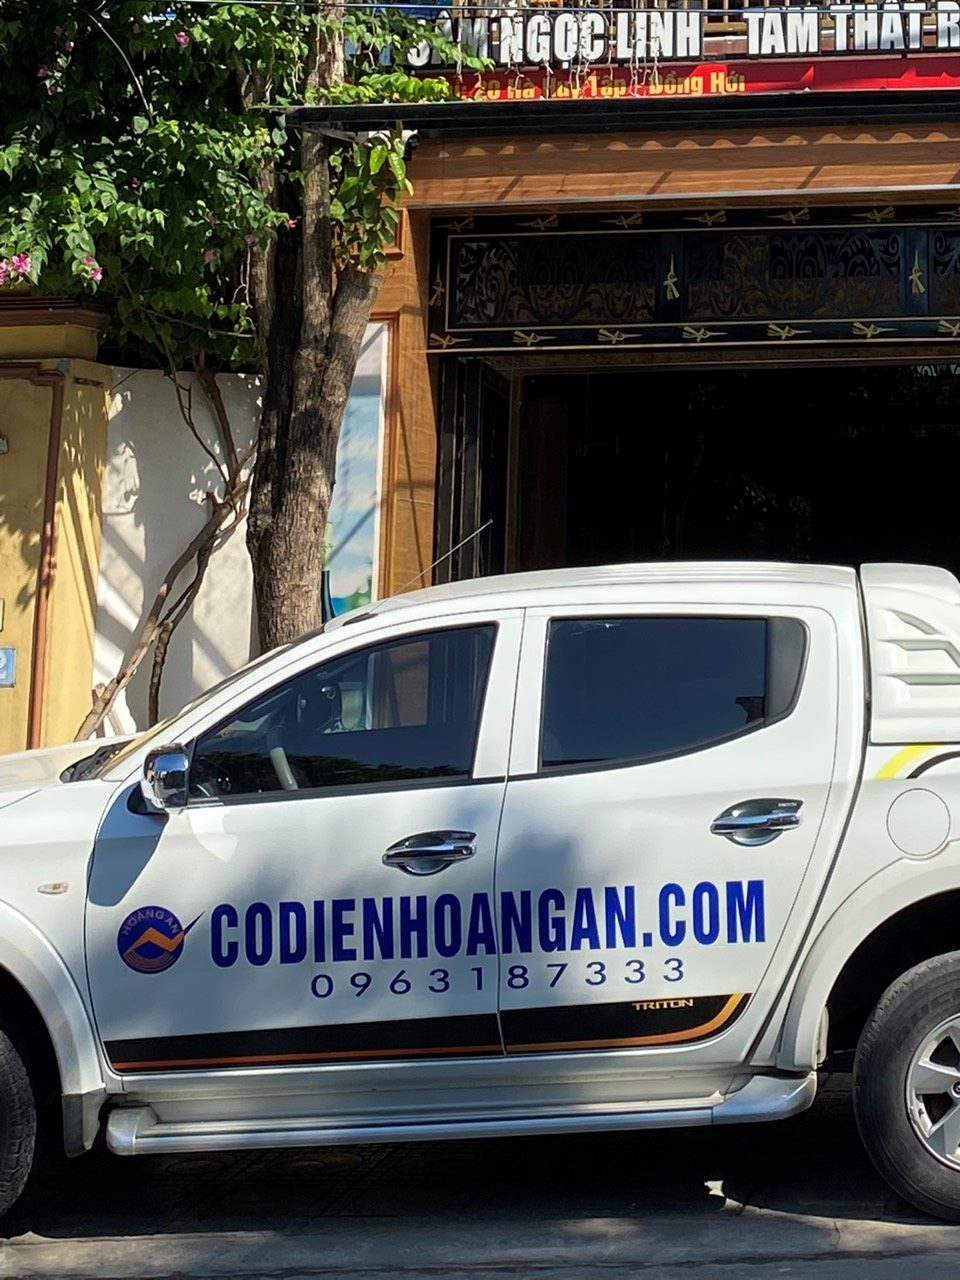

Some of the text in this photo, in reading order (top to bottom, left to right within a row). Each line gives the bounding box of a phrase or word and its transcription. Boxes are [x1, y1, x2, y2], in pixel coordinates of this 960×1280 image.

[500, 12, 605, 69] NGỌC
[616, 10, 701, 60] LINH
[211, 879, 766, 967] CODIENHOANGAN.COM
[310, 956, 686, 998] 0963187333
[632, 998, 694, 1011] TRITON
